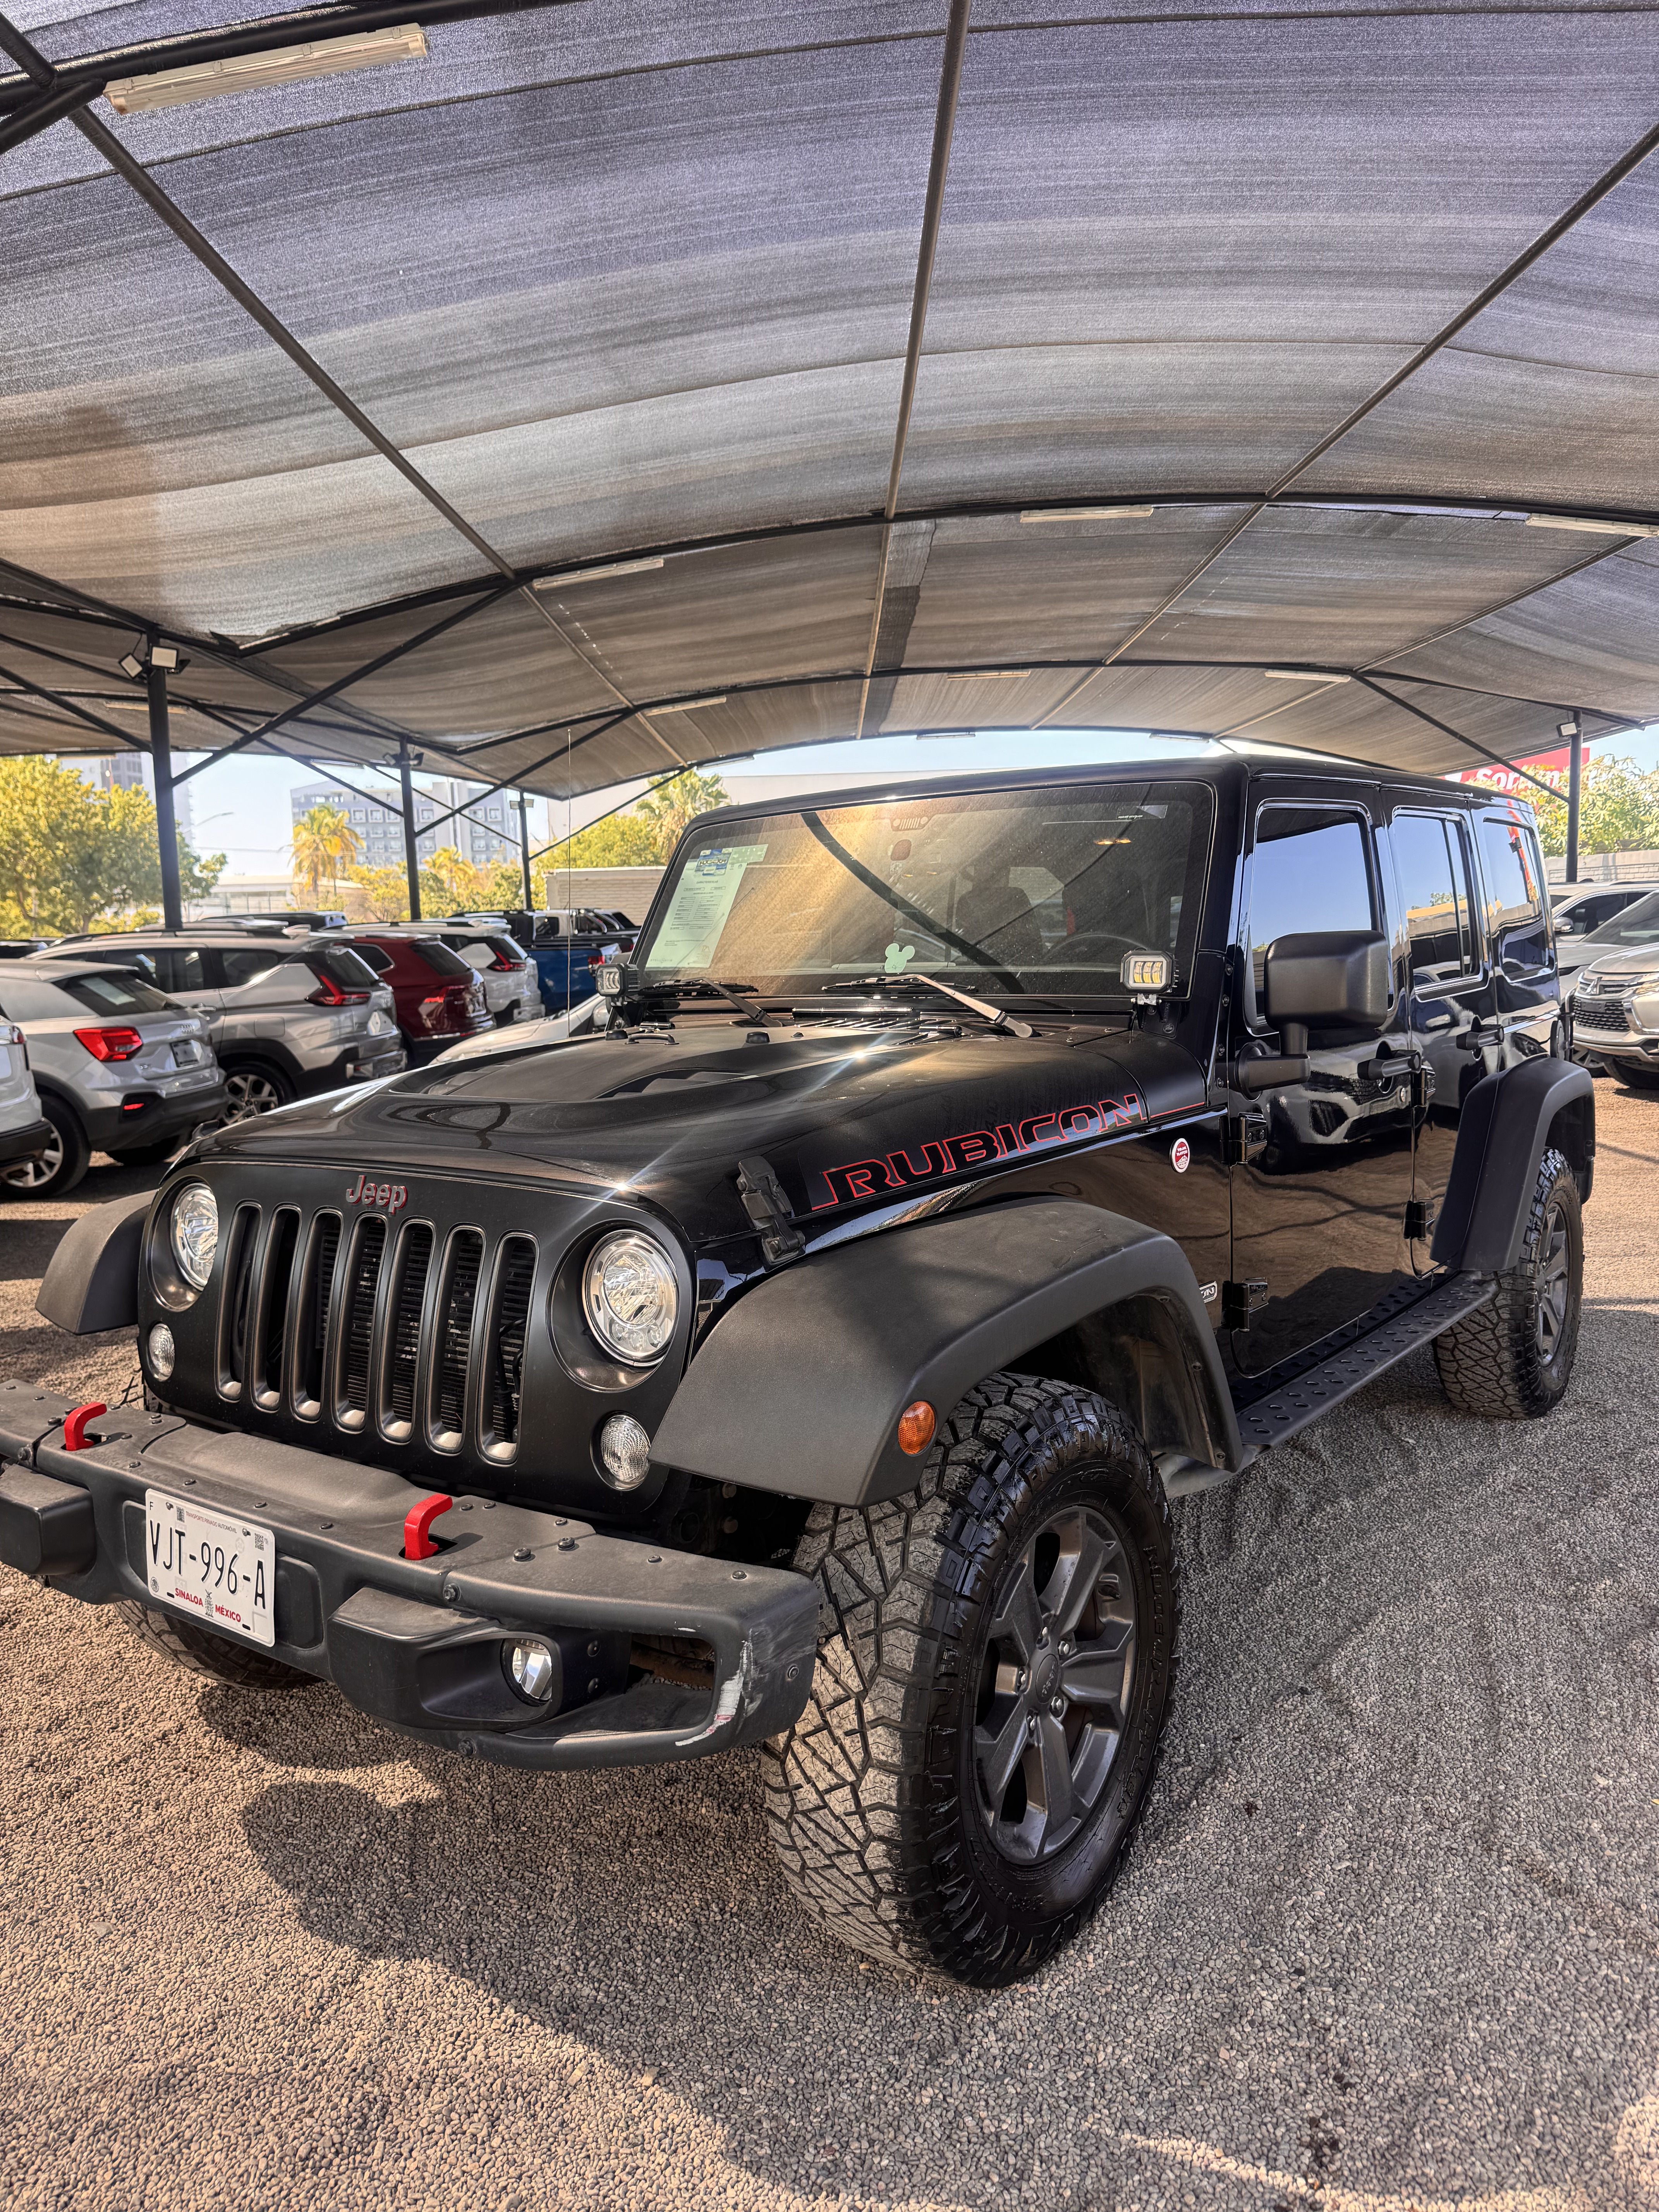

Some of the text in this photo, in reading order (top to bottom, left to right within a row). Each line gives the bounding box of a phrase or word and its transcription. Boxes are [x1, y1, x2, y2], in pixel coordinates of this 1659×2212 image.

[812, 1093, 1147, 1210] RUBICON
[346, 1175, 408, 1214] Jeep
[149, 1501, 154, 1510] F
[149, 1520, 266, 1610] VJT-996-A
[175, 1587, 241, 1623] SINALOA MÉXICO
